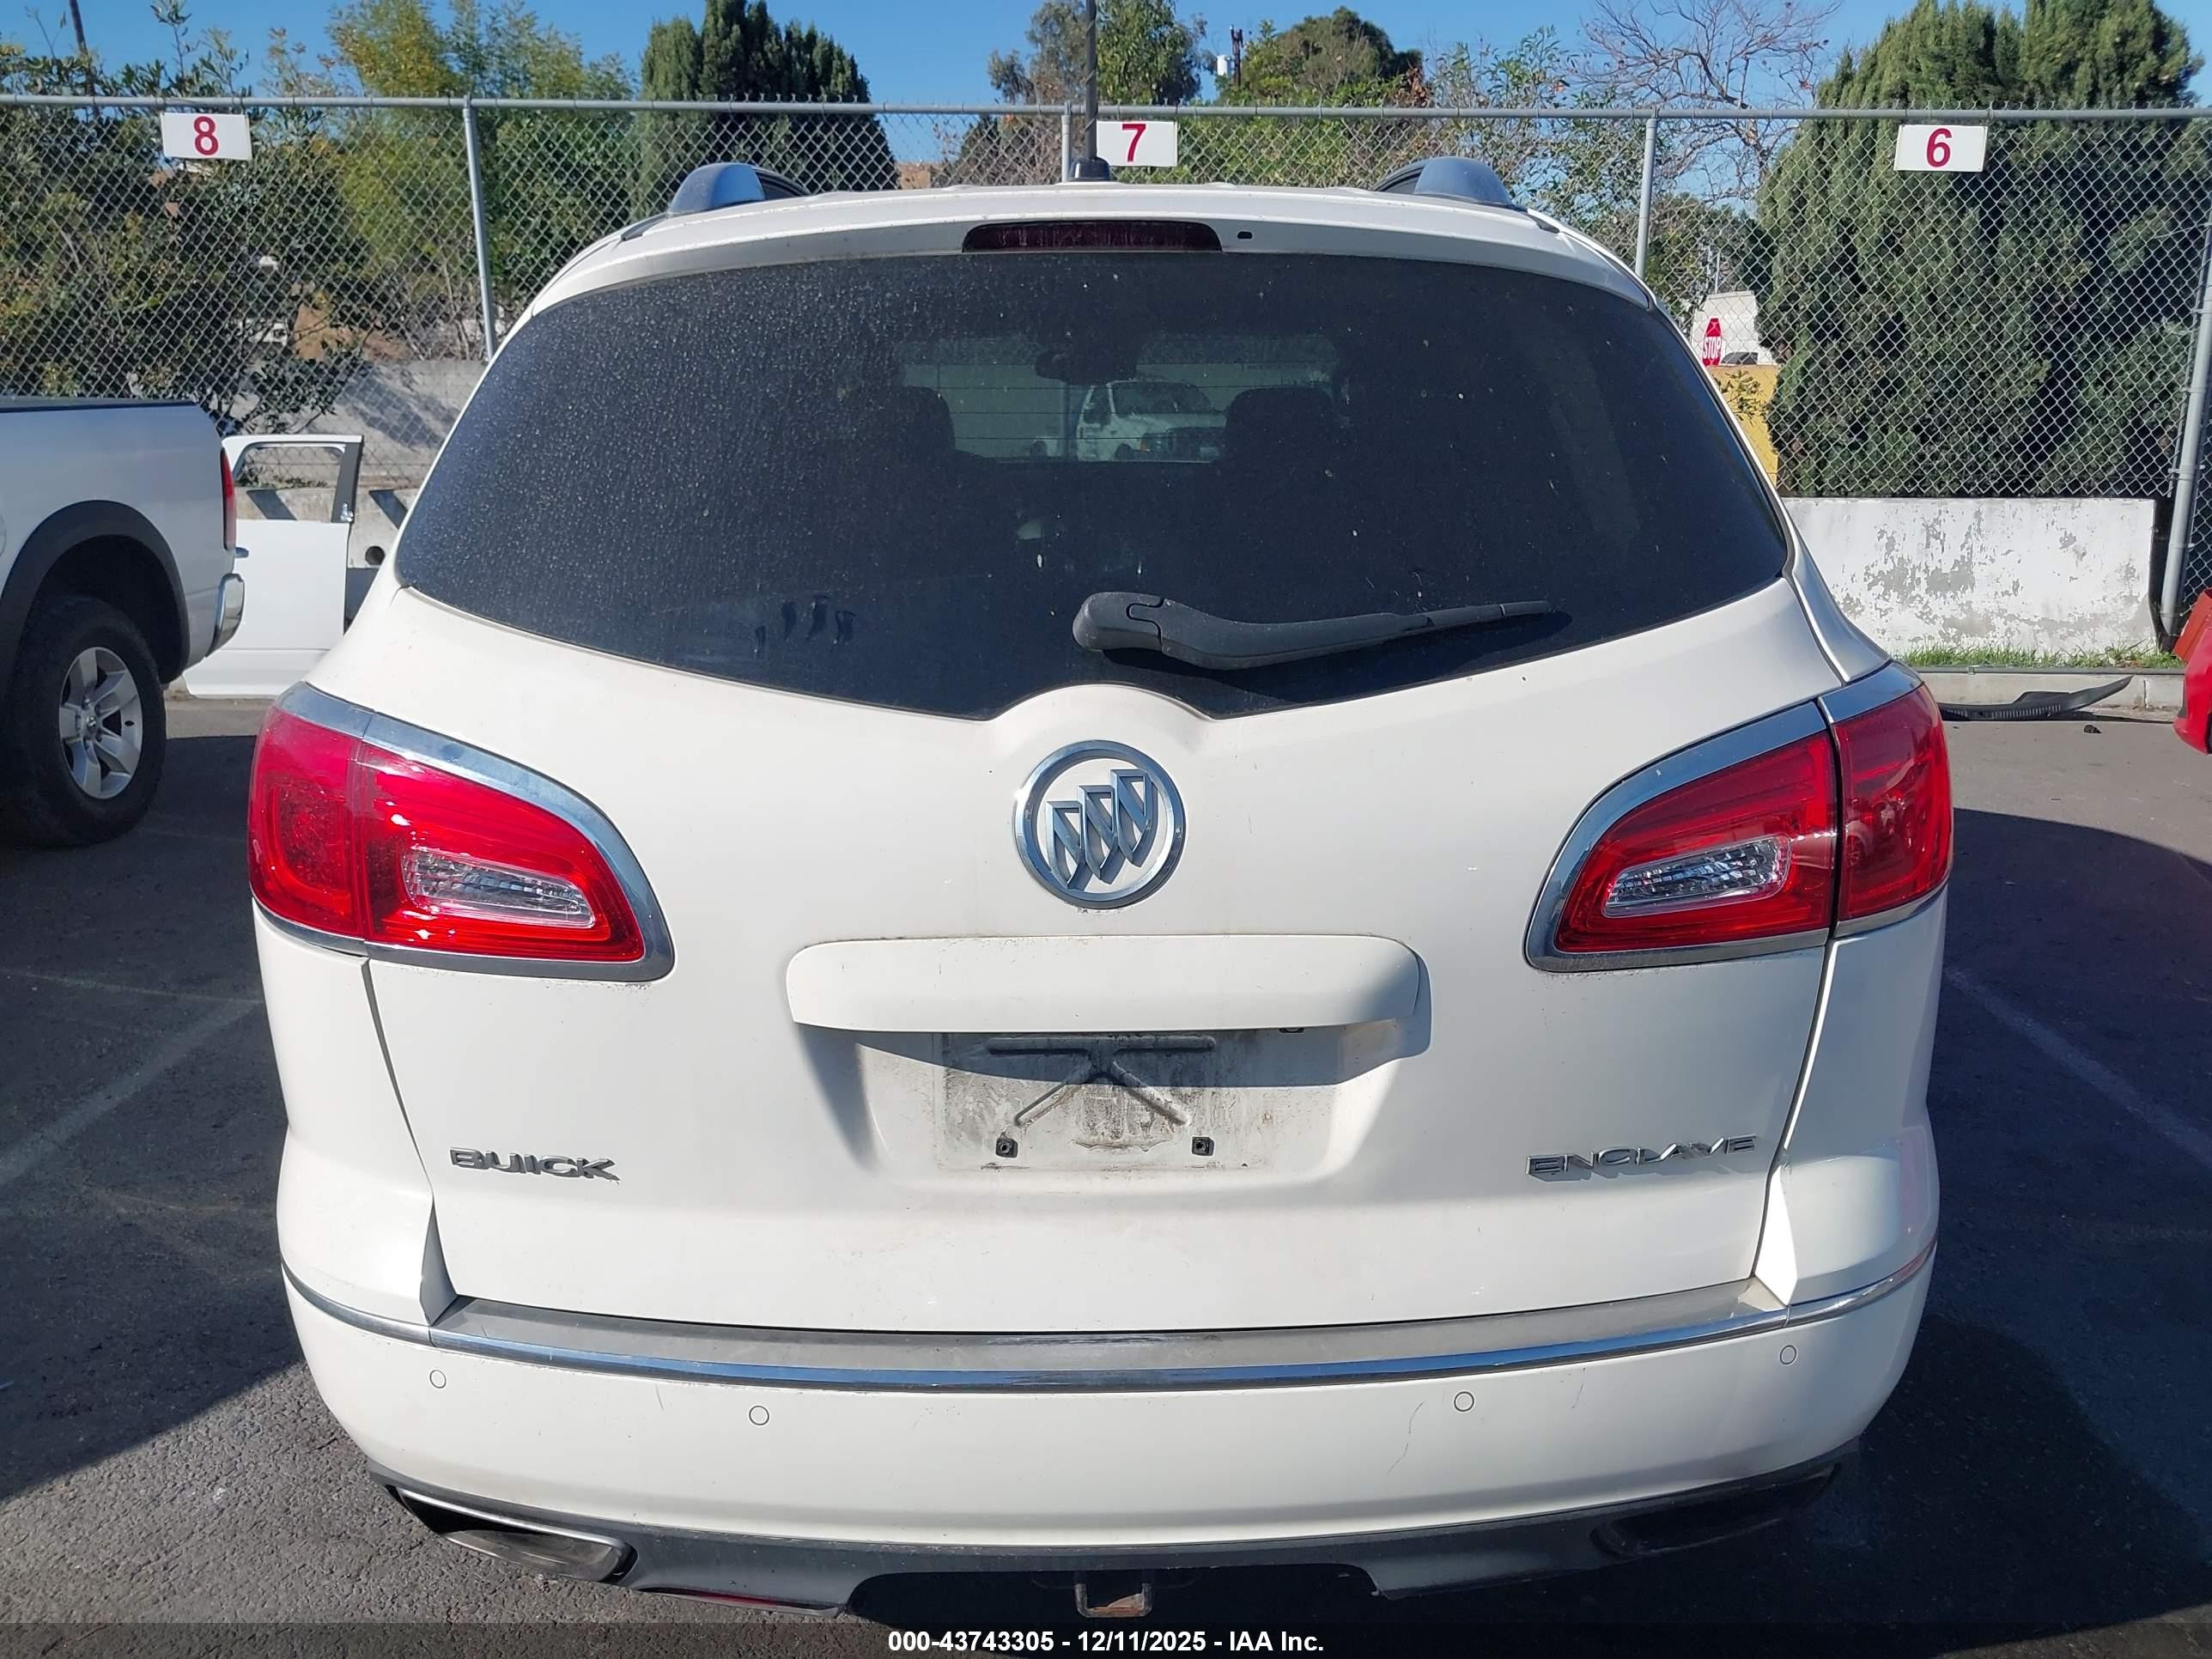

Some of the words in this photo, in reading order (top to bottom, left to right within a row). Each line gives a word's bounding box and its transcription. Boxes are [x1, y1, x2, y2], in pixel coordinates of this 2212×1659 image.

[193, 115, 219, 156] 8
[1121, 122, 1147, 162] 7
[1926, 127, 1952, 168] 6
[1703, 336, 1722, 359] STOP
[450, 1147, 619, 1181] BUICK
[1526, 1134, 1756, 1175] ENCLAVE
